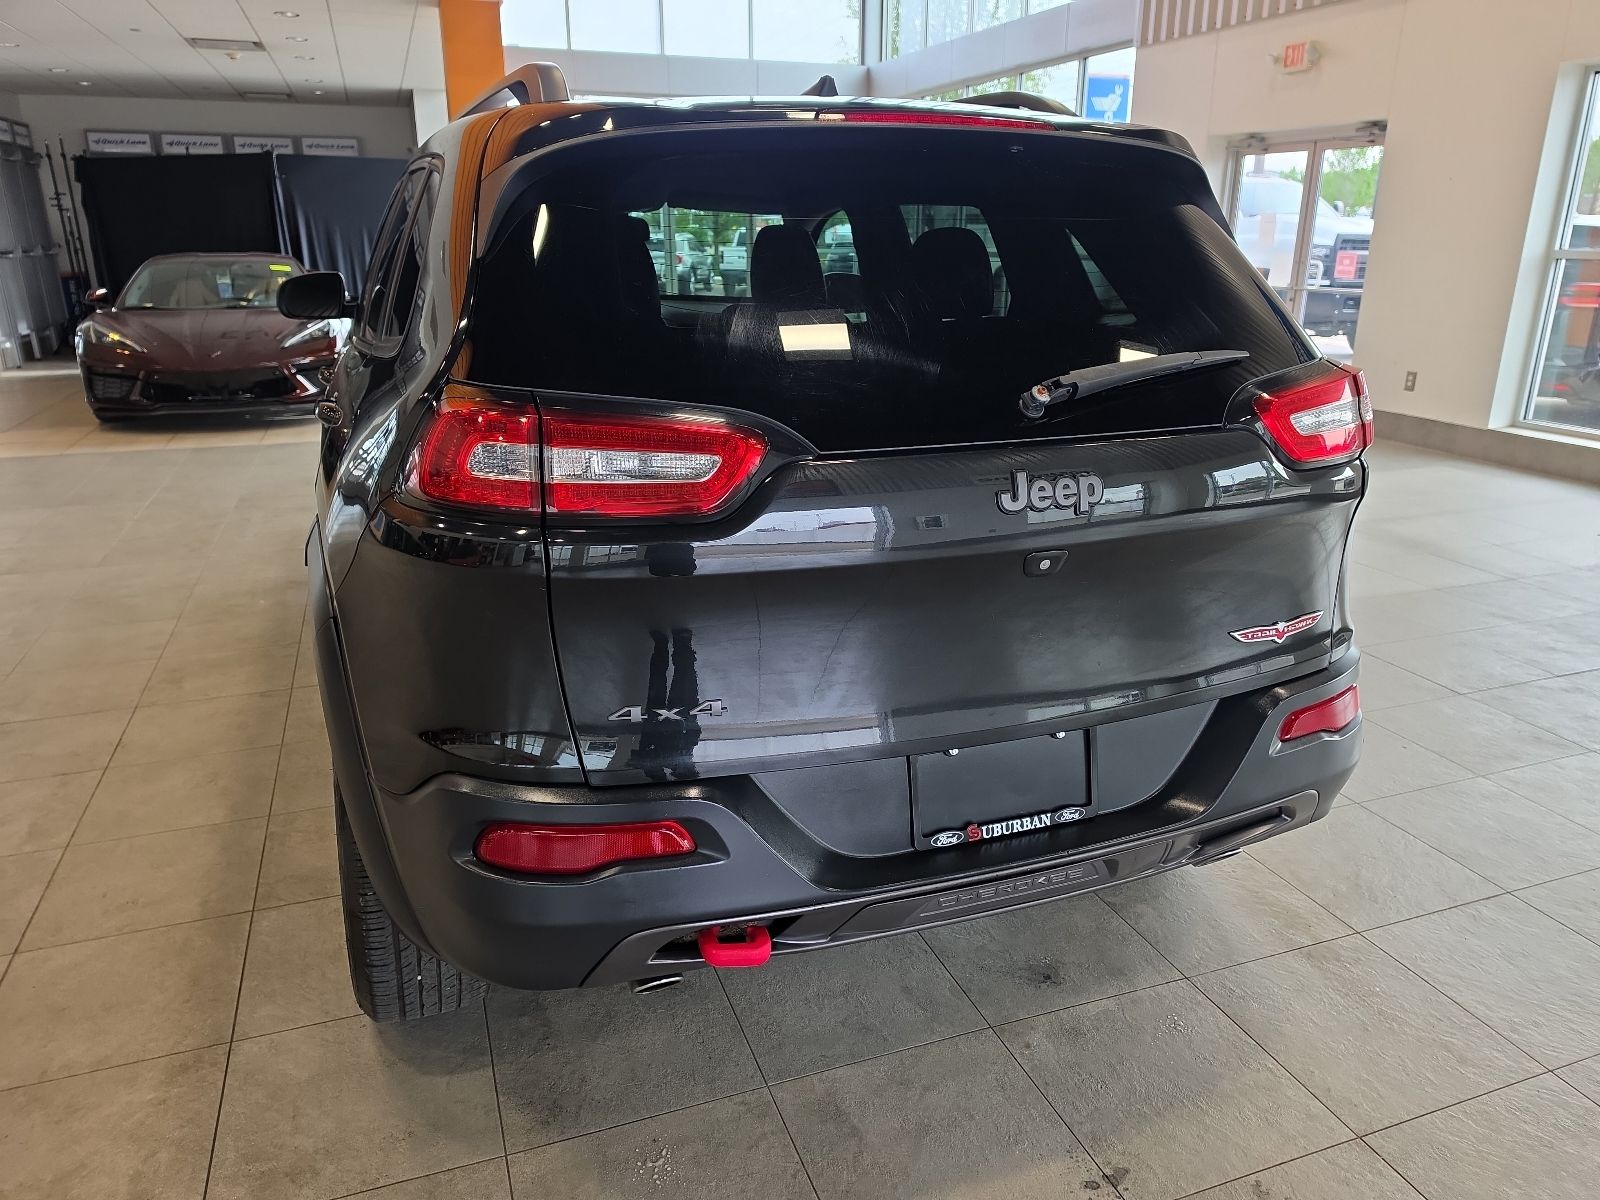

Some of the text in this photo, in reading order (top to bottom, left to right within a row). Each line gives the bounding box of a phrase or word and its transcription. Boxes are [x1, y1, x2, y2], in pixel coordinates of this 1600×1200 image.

[1284, 42, 1306, 68] EXIT
[996, 469, 1103, 515] Jeep
[608, 699, 728, 722] 4x4
[935, 808, 1081, 846] Ford SUBURBAN Ford
[937, 867, 1084, 907] CHEROKEE
